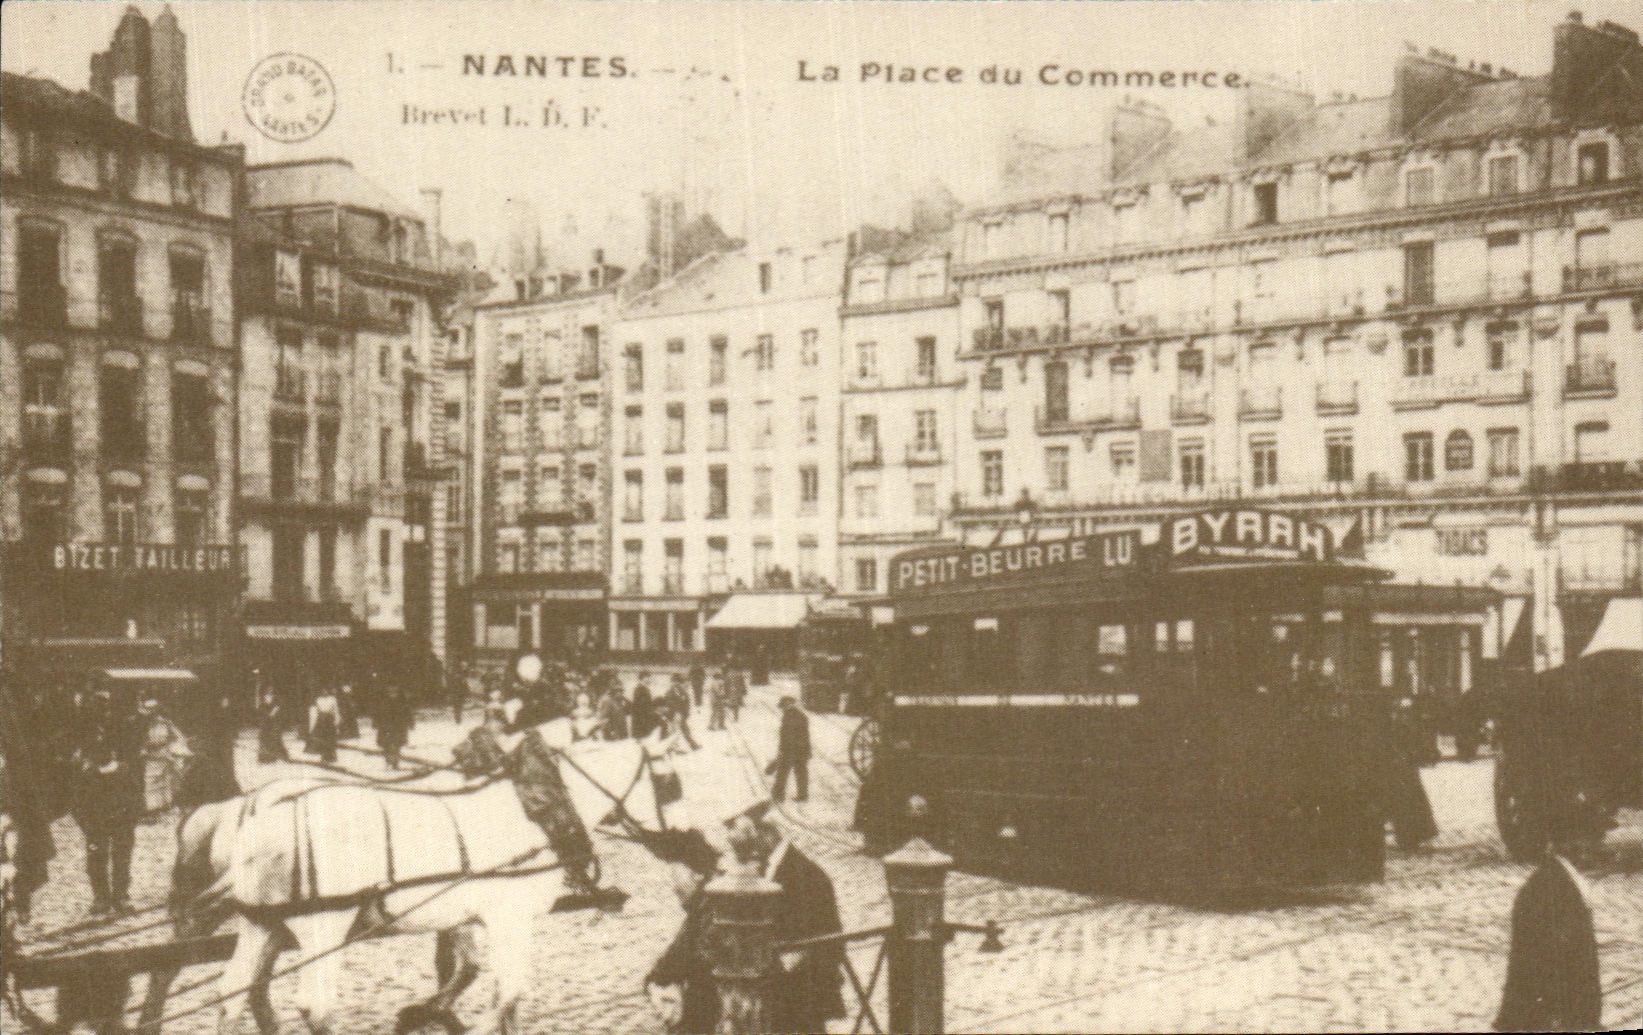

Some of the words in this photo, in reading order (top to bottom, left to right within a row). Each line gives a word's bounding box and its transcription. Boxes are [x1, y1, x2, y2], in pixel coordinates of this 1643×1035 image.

[1172, 511, 1325, 561] BYRRH
[54, 544, 120, 569] BIZET
[135, 546, 231, 571] TAILLEUR
